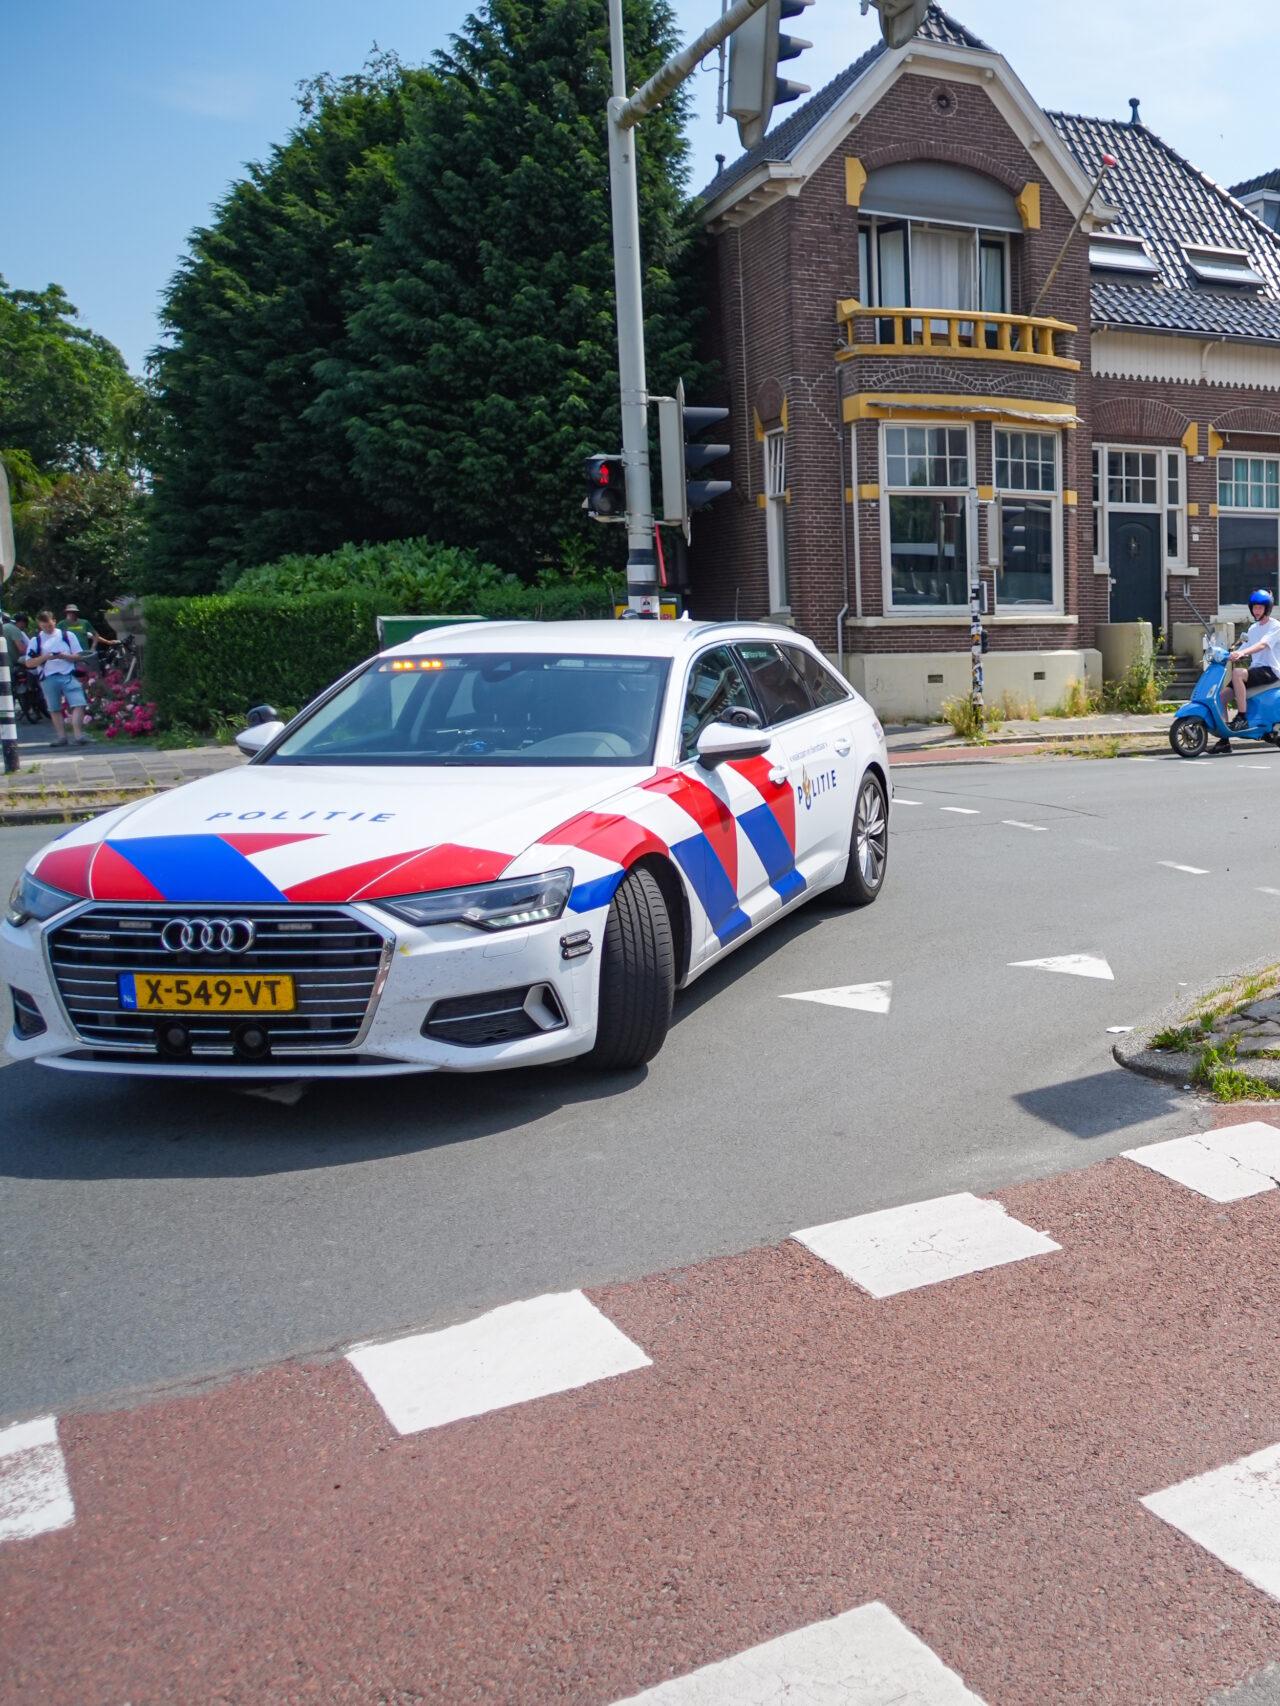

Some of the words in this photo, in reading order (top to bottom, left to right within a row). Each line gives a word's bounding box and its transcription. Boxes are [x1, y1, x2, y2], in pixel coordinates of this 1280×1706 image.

[797, 769, 837, 810] POLITIE
[205, 811, 397, 822] POLITIE
[145, 980, 281, 1006] X-549-VT
